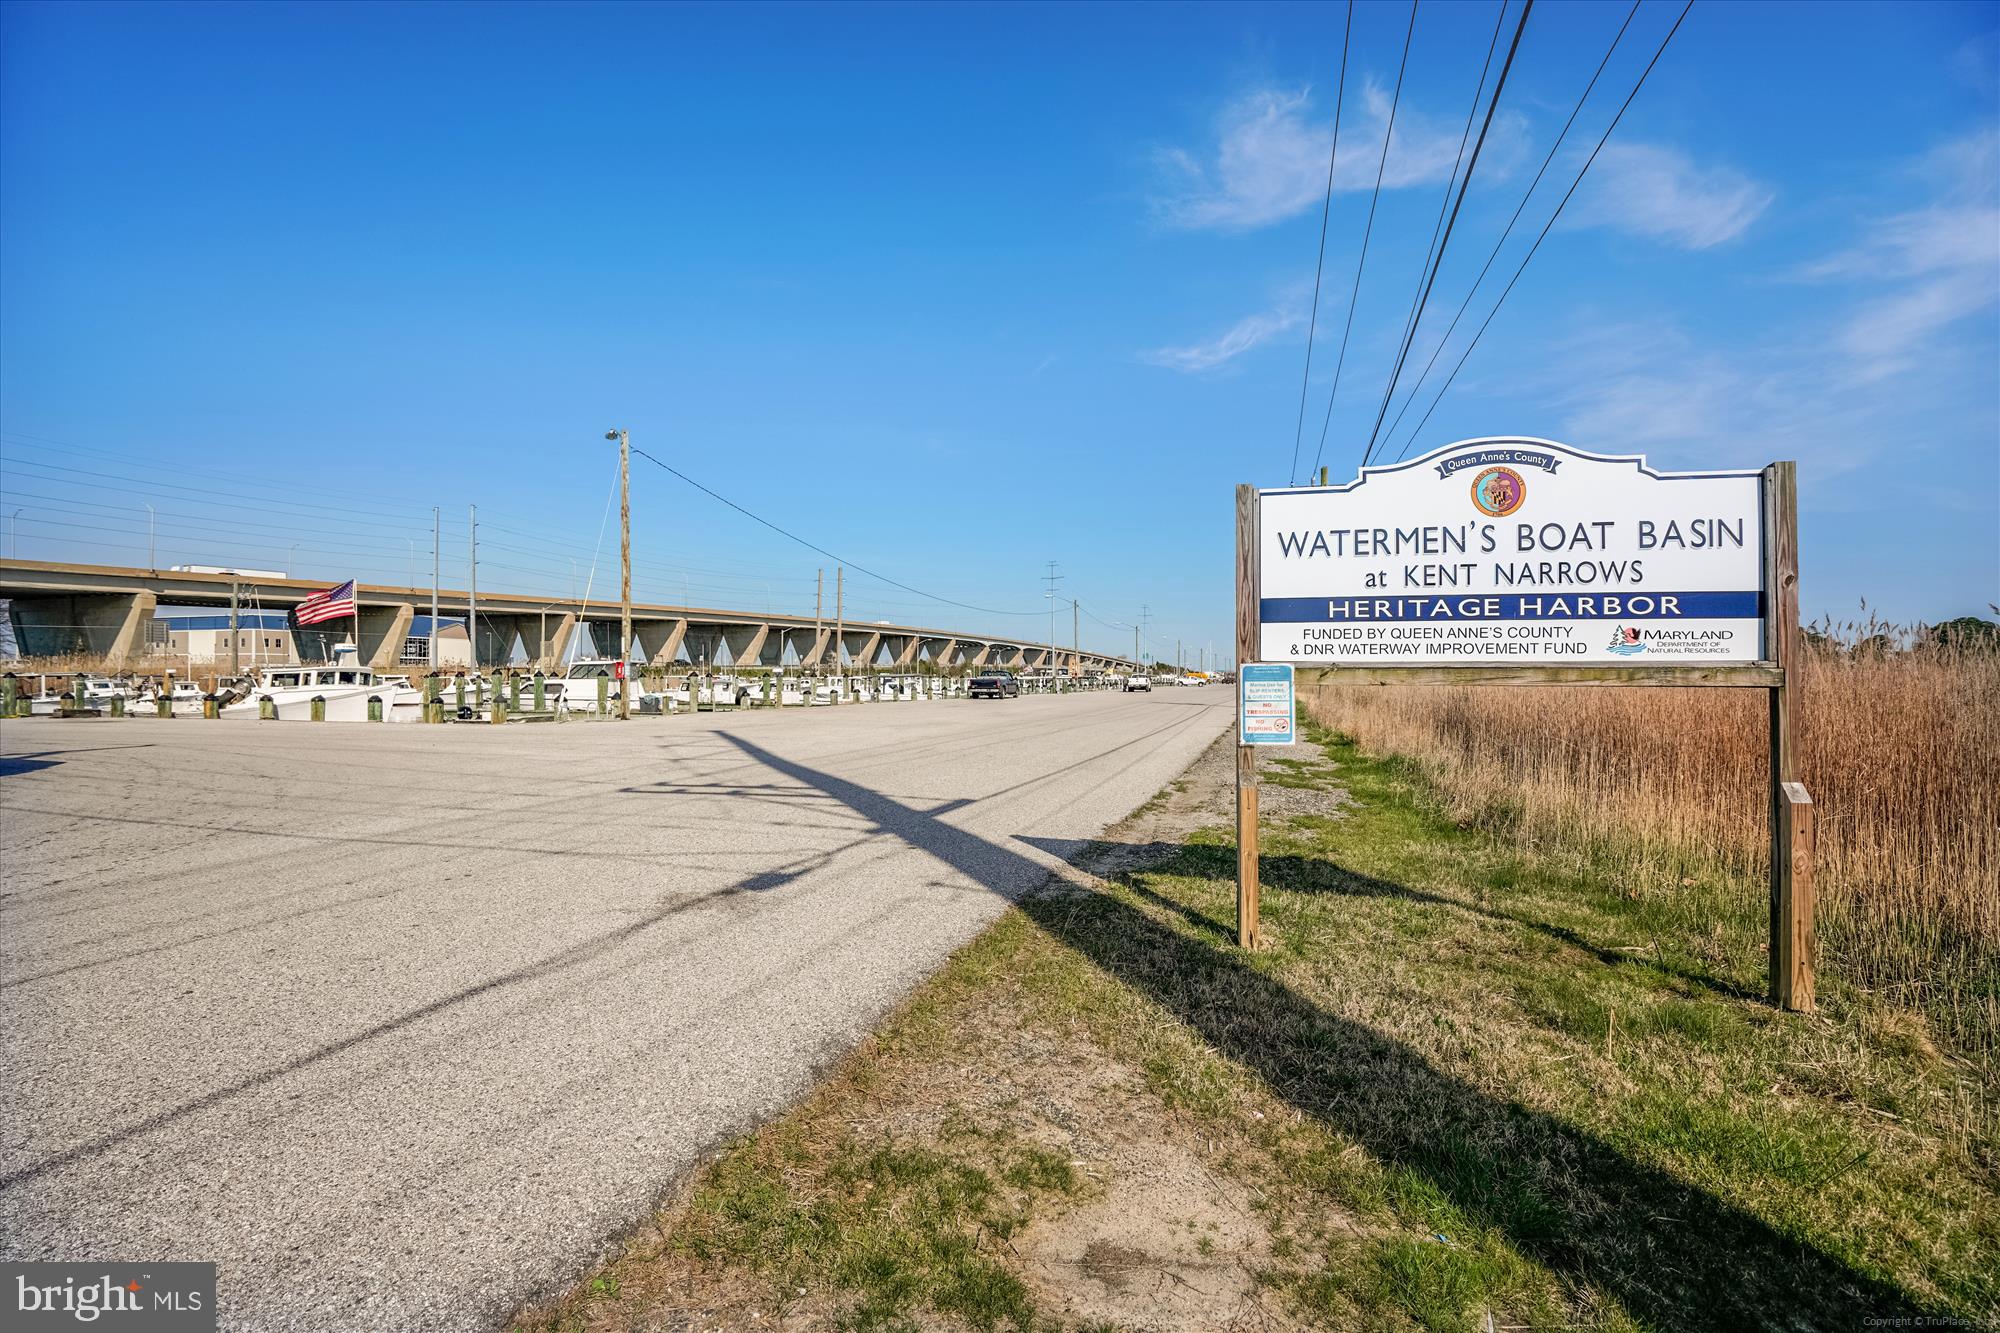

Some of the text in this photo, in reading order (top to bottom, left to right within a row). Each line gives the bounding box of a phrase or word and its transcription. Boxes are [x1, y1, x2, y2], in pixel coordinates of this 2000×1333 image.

[1447, 451, 1548, 470] Queen Anne's County
[1277, 518, 1744, 559] WATERMEN'S BOAT BASIN
[1365, 560, 1643, 588] at KENT NARROWS
[1328, 596, 1682, 618] HERITAGE HARBOR
[1303, 626, 1574, 641] FUNDED BY QUEEN ANNE'S COUNTY
[1644, 630, 1733, 640] MARYLAND
[1290, 642, 1587, 655] & DNR WATERWAY IMPROVEMENT FUND
